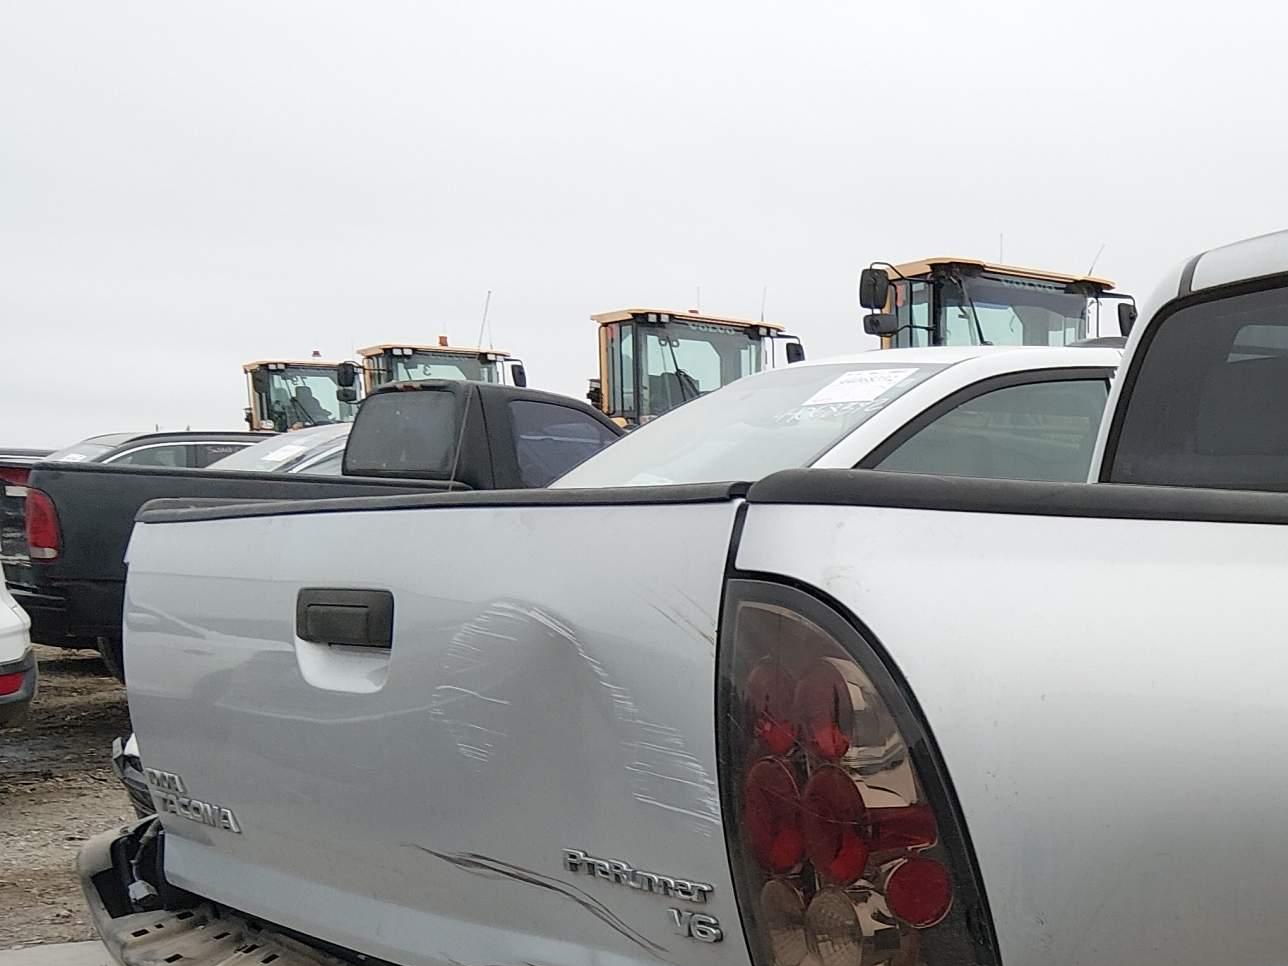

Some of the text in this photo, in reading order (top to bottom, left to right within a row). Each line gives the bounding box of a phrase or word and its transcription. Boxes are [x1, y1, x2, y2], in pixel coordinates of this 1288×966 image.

[153, 790, 242, 834] TACOMA
[562, 848, 714, 903] PreRunner
[667, 907, 724, 943] V6
